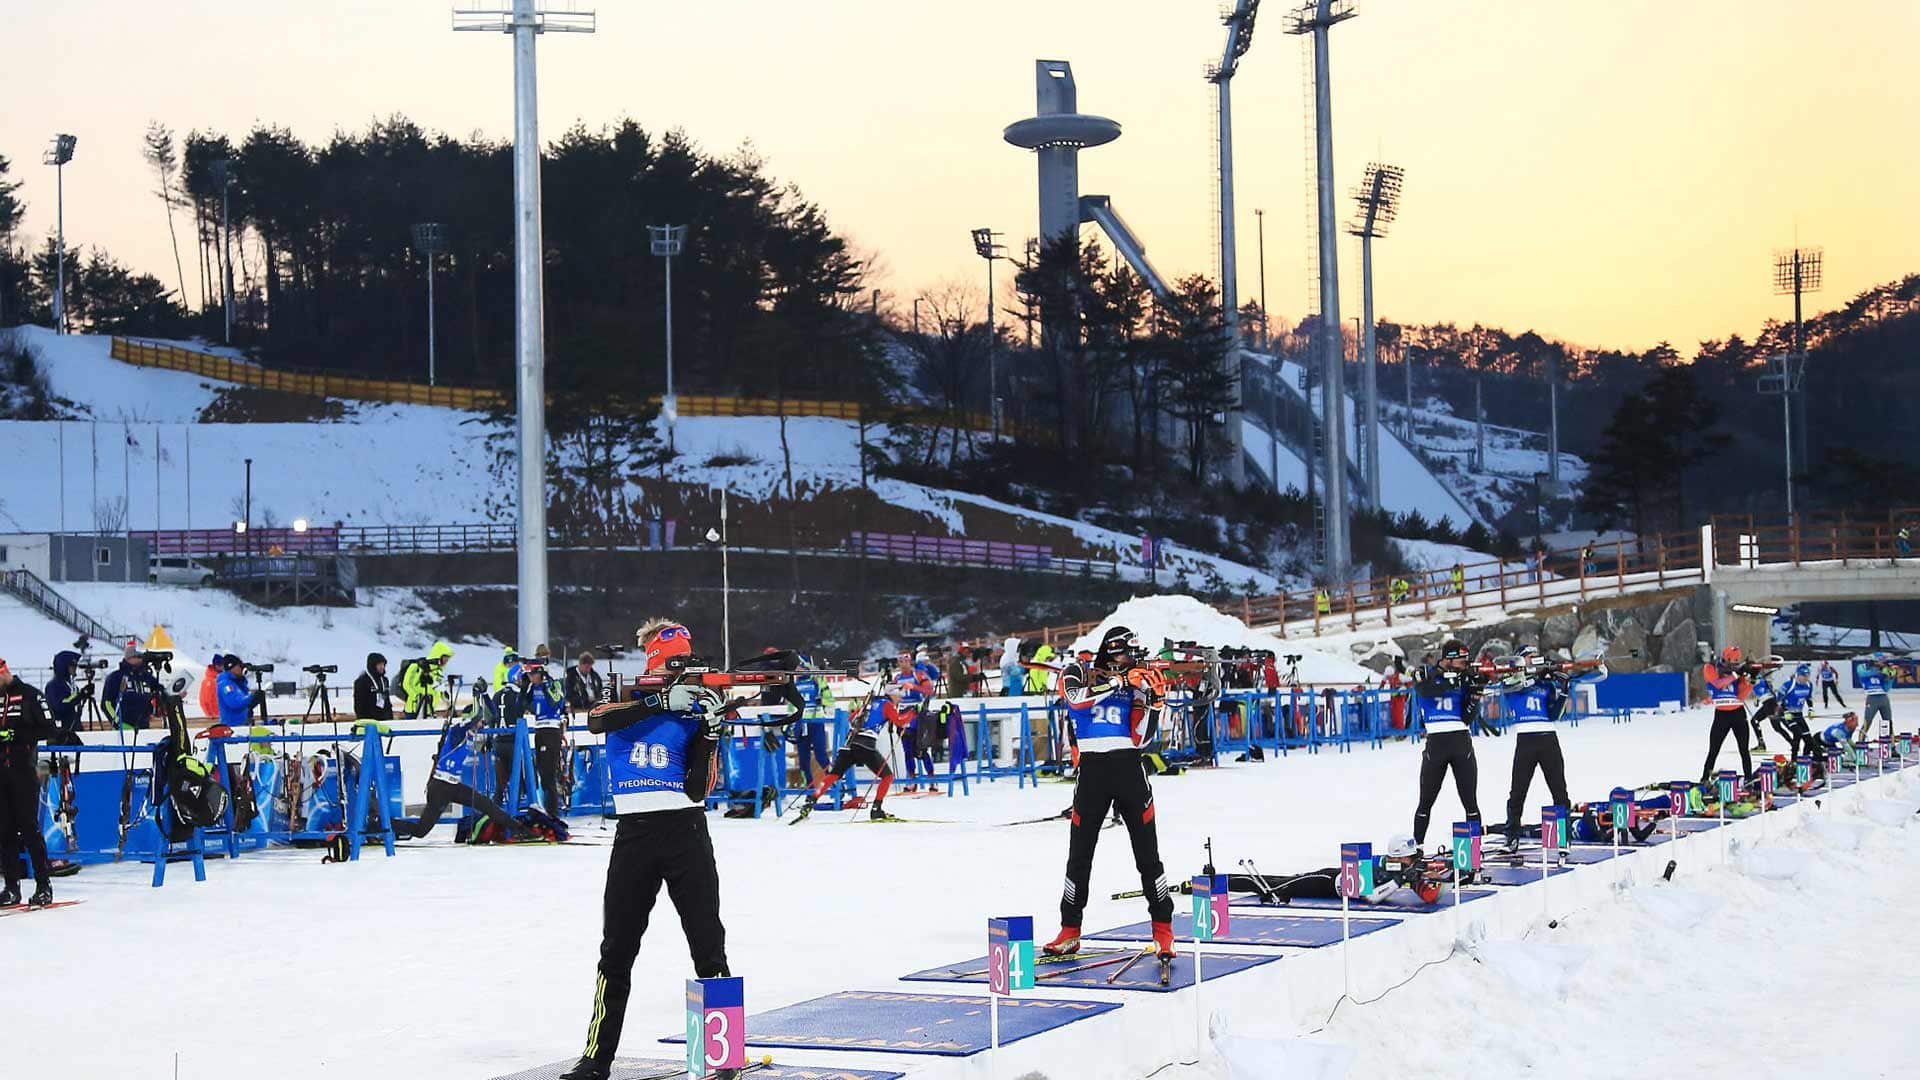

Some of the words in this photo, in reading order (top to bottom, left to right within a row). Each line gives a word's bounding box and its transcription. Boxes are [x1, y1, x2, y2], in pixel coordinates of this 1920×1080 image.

[1091, 705, 1122, 725] 26
[629, 741, 669, 769] 46
[1856, 749, 1865, 765] 14
[1880, 743, 1889, 758] 15
[1901, 740, 1909, 753] 16
[1798, 765, 1808, 783] 12
[1828, 757, 1837, 773] 13
[1721, 780, 1732, 802] 10
[1762, 773, 1773, 793] 11
[1616, 803, 1625, 828] 8
[1673, 793, 1683, 815] 9
[1546, 821, 1555, 848] 7
[1457, 839, 1468, 868] 6
[1346, 863, 1355, 896] 5
[1197, 898, 1208, 937] 4
[1210, 896, 1220, 935] 5
[994, 946, 1004, 991] 3
[1008, 942, 1024, 987] 4
[691, 1014, 700, 1072] 2
[704, 1010, 730, 1067] 3
